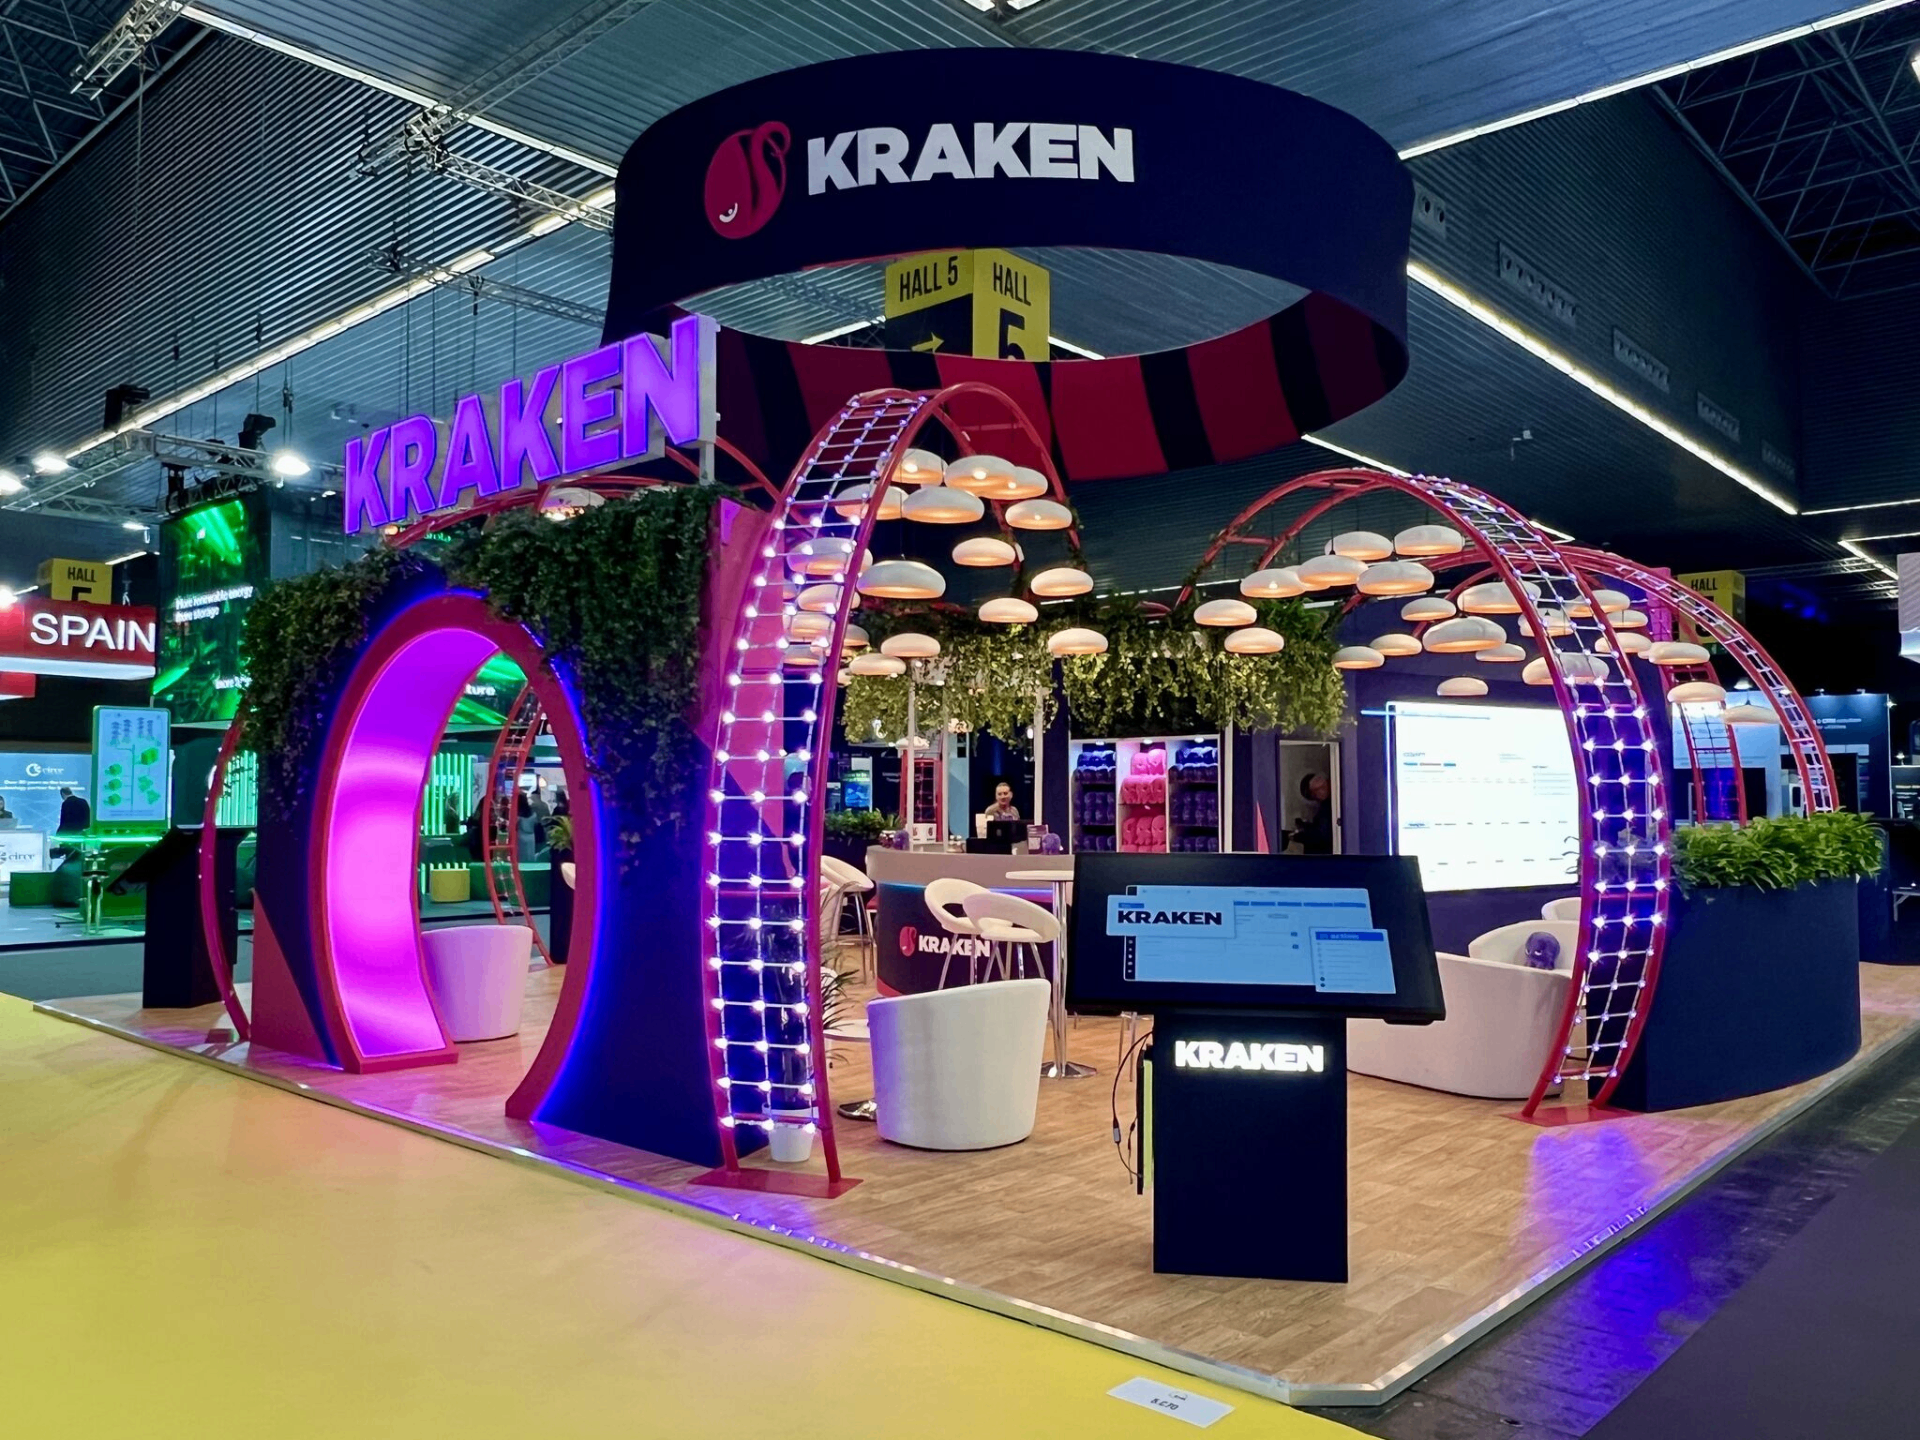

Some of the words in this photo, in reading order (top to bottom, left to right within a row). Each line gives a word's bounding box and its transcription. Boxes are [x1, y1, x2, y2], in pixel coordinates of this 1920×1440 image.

[807, 122, 1135, 196] KRAKEN
[900, 262, 942, 302] HALL
[947, 256, 958, 286] 5
[993, 262, 1031, 306] HALL
[344, 314, 701, 535] KRAKEN
[67, 566, 97, 583] HALL
[1690, 577, 1718, 591] HALL
[30, 612, 156, 653] SPAIN
[464, 683, 497, 696] ture
[1118, 910, 1222, 926] KRAKEN
[918, 934, 990, 957] KRAKEN
[1174, 1040, 1325, 1073] KRAKEN
